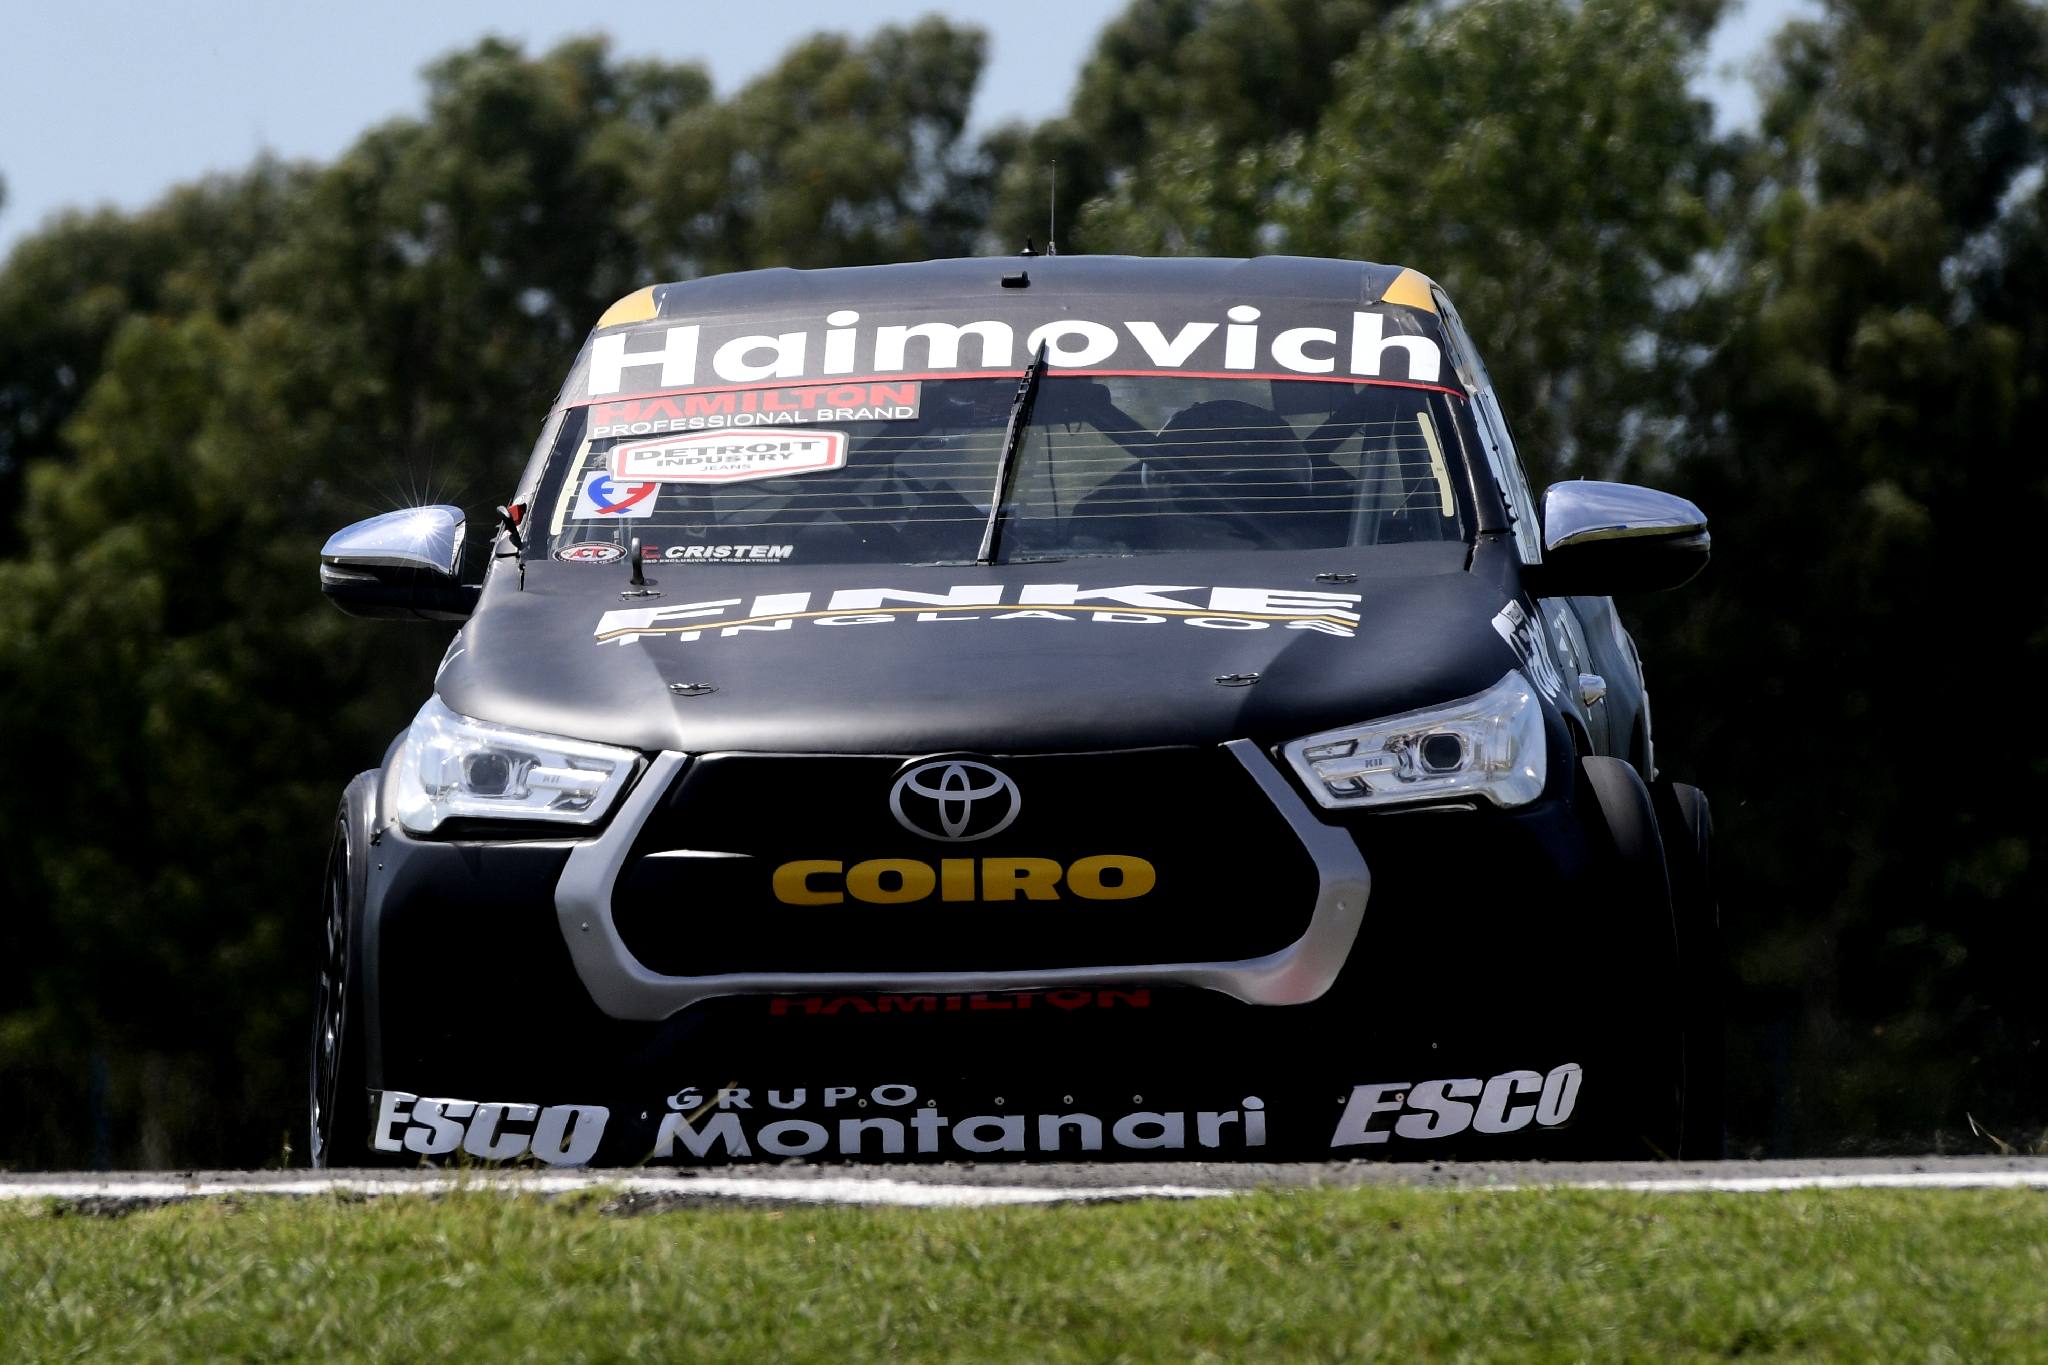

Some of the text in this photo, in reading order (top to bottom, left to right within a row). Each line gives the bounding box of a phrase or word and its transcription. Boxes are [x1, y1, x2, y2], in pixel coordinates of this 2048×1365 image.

[588, 308, 1441, 395] Haimovich
[593, 406, 914, 439] PROFESSIONAL BRAND
[595, 383, 916, 425] HAMILTON
[633, 440, 820, 461] DETROIT
[656, 451, 795, 467] INDUSTRY
[701, 463, 752, 472] JEANS
[665, 545, 794, 558] CRISTEM
[595, 584, 1361, 636] FINKE
[772, 854, 1156, 905] COIRO
[769, 990, 1151, 1015] HAMILTON
[654, 1096, 1266, 1156] Montanari
[1330, 1063, 1583, 1147] ESCO
[374, 1090, 610, 1165] ESCO
